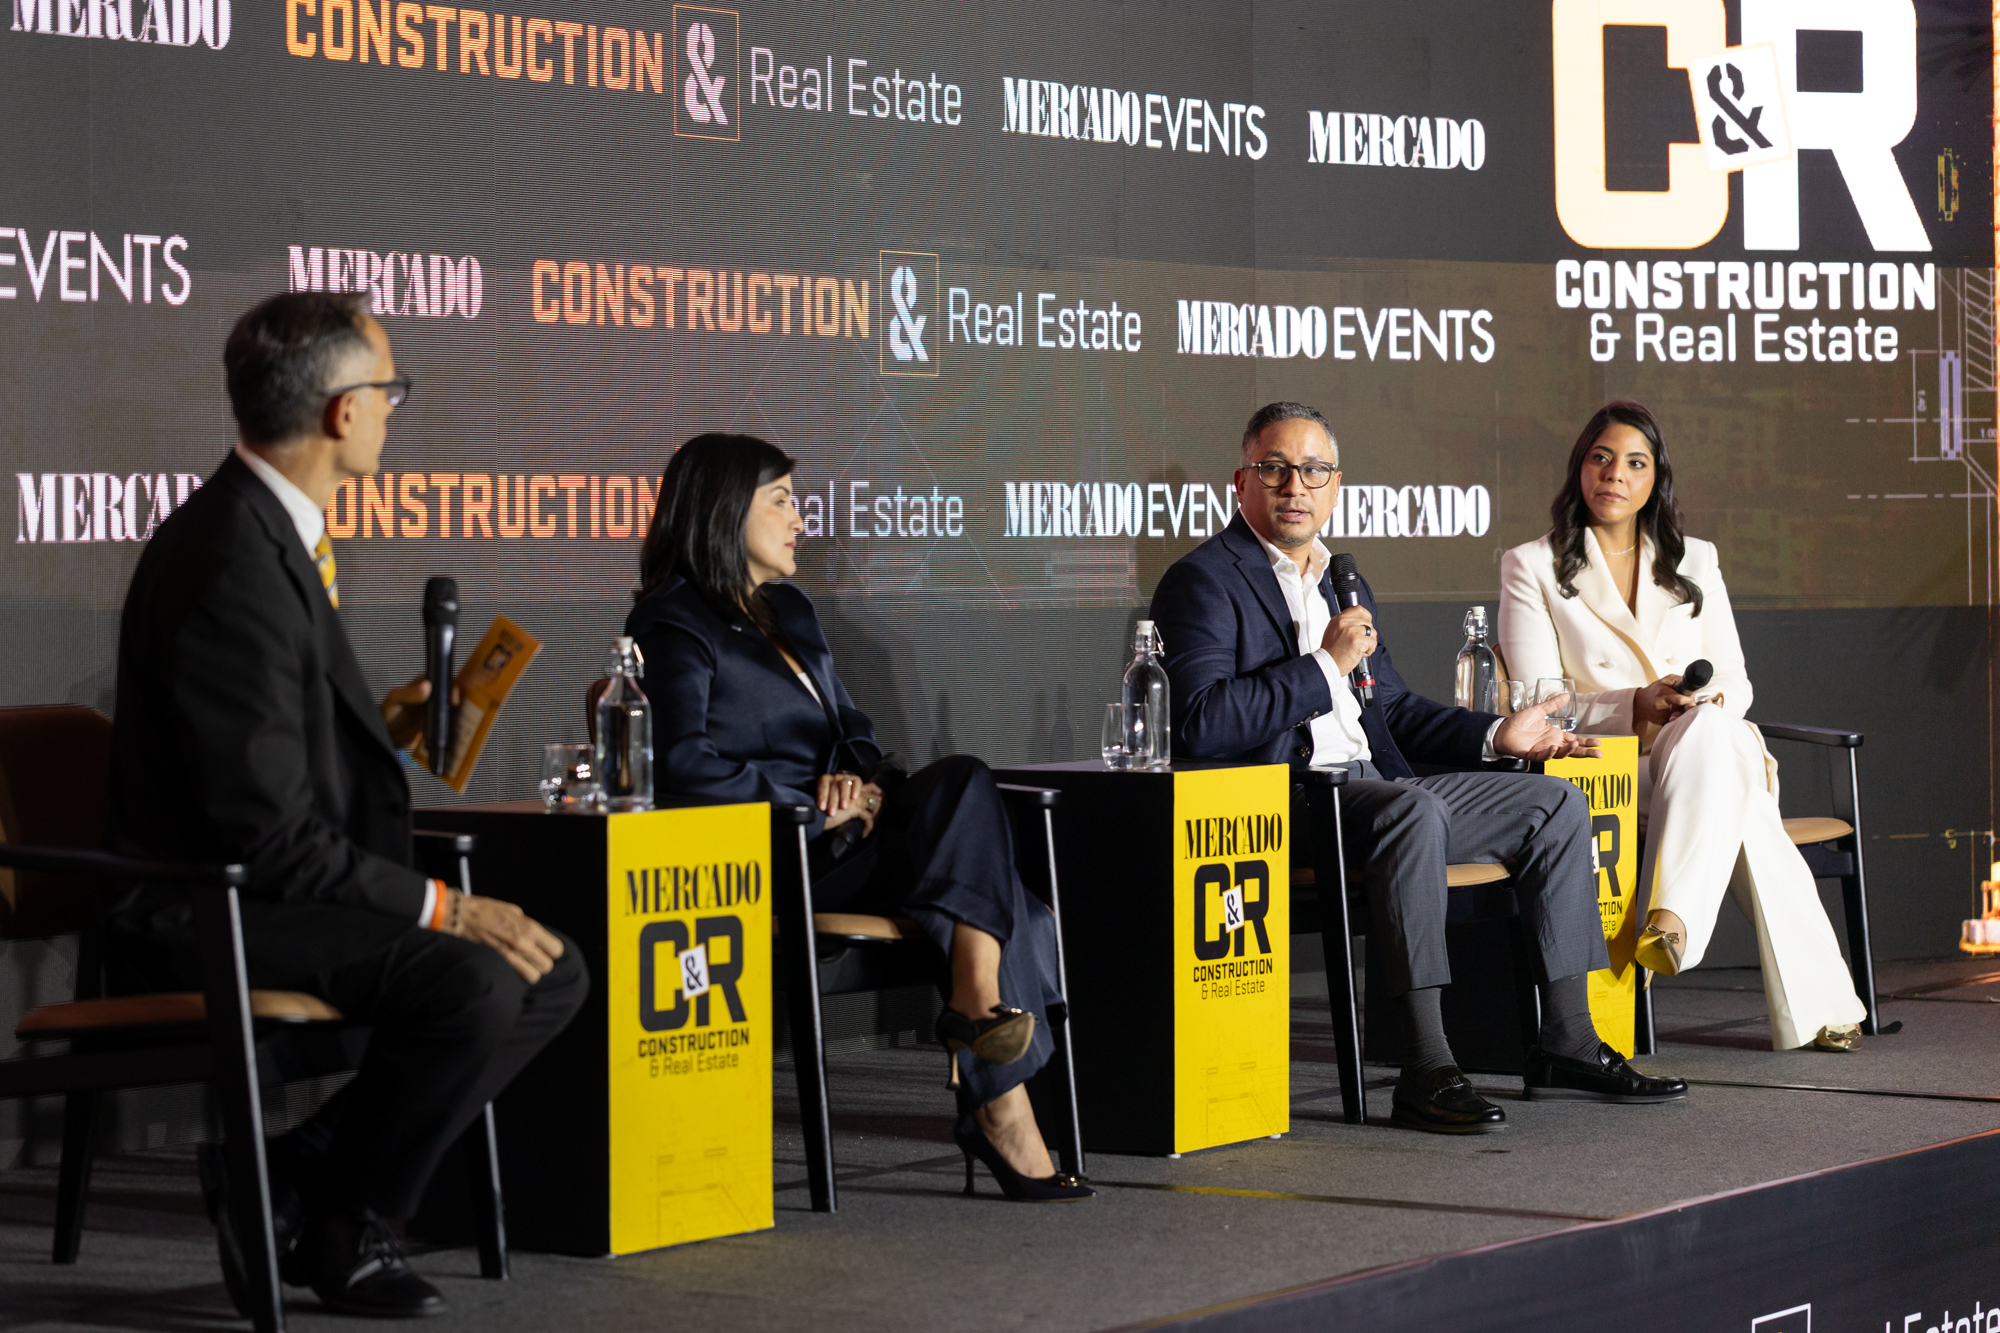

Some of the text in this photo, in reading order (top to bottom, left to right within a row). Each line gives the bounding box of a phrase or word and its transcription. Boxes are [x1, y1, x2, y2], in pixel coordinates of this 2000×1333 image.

[286, 0, 963, 127] CONSTRUCTION & Real Estate
[1307, 110, 1486, 171] MERCADO
[532, 259, 1143, 363] CONSTRUCTION & Real Estate
[1555, 259, 1937, 311] CONSTRUCTION
[1590, 312, 1899, 362] & Real Estate
[15, 472, 203, 543] MERCA
[326, 472, 664, 539] ONSTRUCTION
[849, 480, 965, 538] Estate
[1184, 813, 1283, 860] MERCADO
[624, 859, 762, 916] MERCADO
[1193, 957, 1273, 983] CONSTRUCTION
[1211, 977, 1233, 999] Real
[1234, 978, 1266, 996] Estate
[638, 1027, 750, 1058] CONSTRUCTION
[663, 1053, 693, 1076] Real
[697, 1051, 740, 1073] Estate
